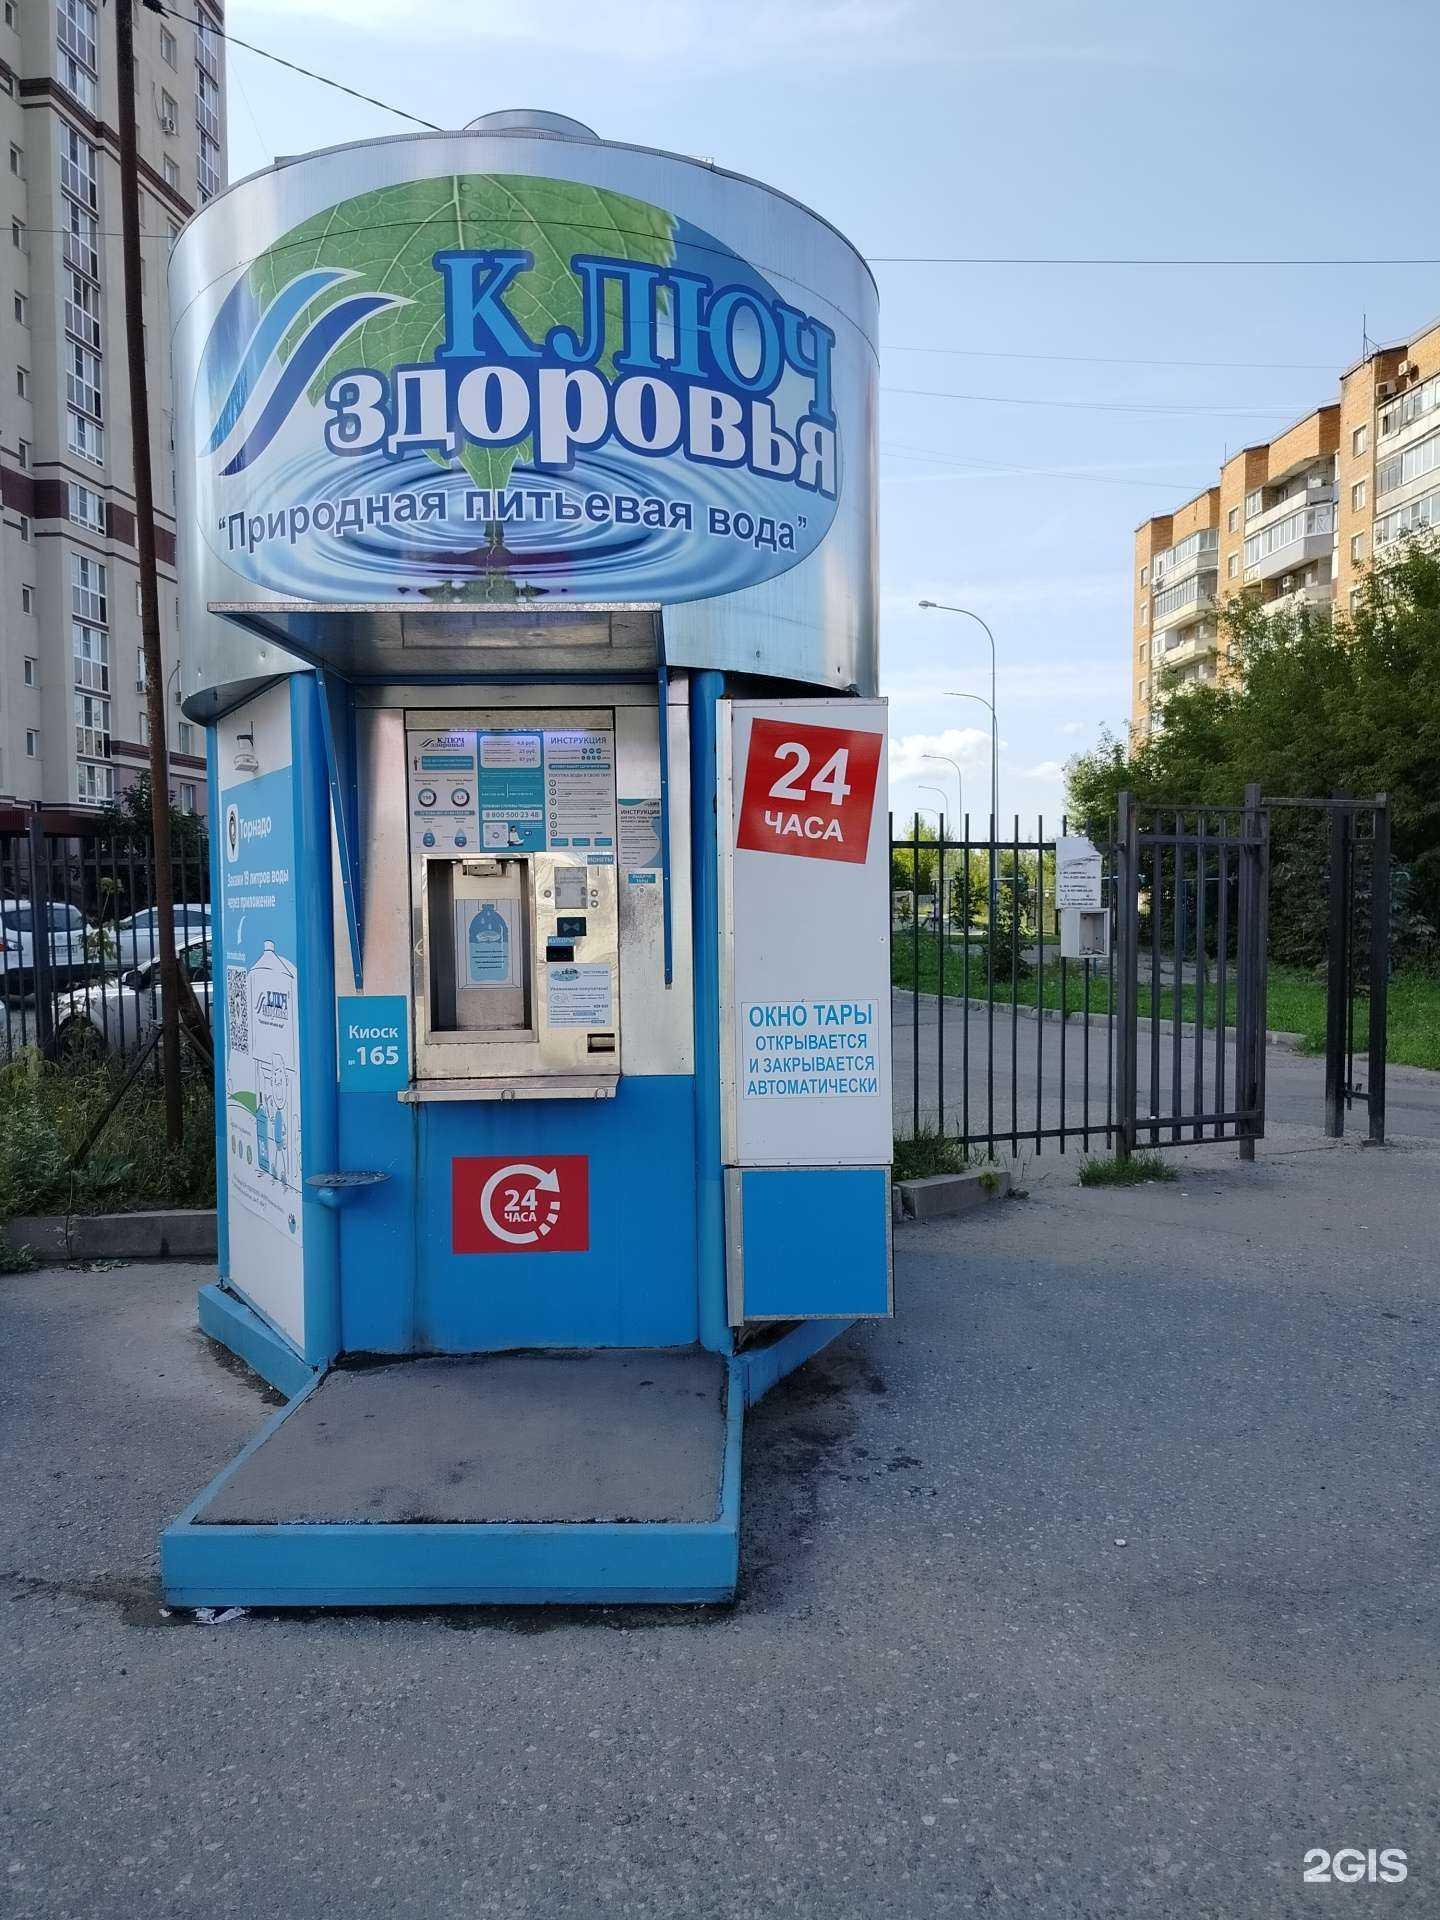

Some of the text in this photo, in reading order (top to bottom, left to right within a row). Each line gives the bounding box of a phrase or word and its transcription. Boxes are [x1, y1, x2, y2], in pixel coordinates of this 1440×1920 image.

[435, 250, 836, 428] КЛЮЧ
[326, 364, 837, 499] здоровья
[465, 488, 693, 531] питьевая
[550, 736, 607, 745] ИНСТРУКЦИЯ
[768, 741, 852, 806] 24
[240, 816, 272, 842] Торнадо
[764, 810, 844, 842] ЧАСА
[271, 869, 289, 886] воды
[748, 1003, 872, 1028] ОКНО ТАРЫ
[348, 1024, 400, 1039] Киоск
[755, 1033, 868, 1052] ОТКРЫВАЕТСЯ
[749, 1055, 875, 1073] И ЗАКРЫВАЕТСЯ
[747, 1077, 878, 1096] АВТОМАТИЧЕСКИ
[504, 1188, 538, 1212] 24
[504, 1212, 537, 1223] ЧАСА
